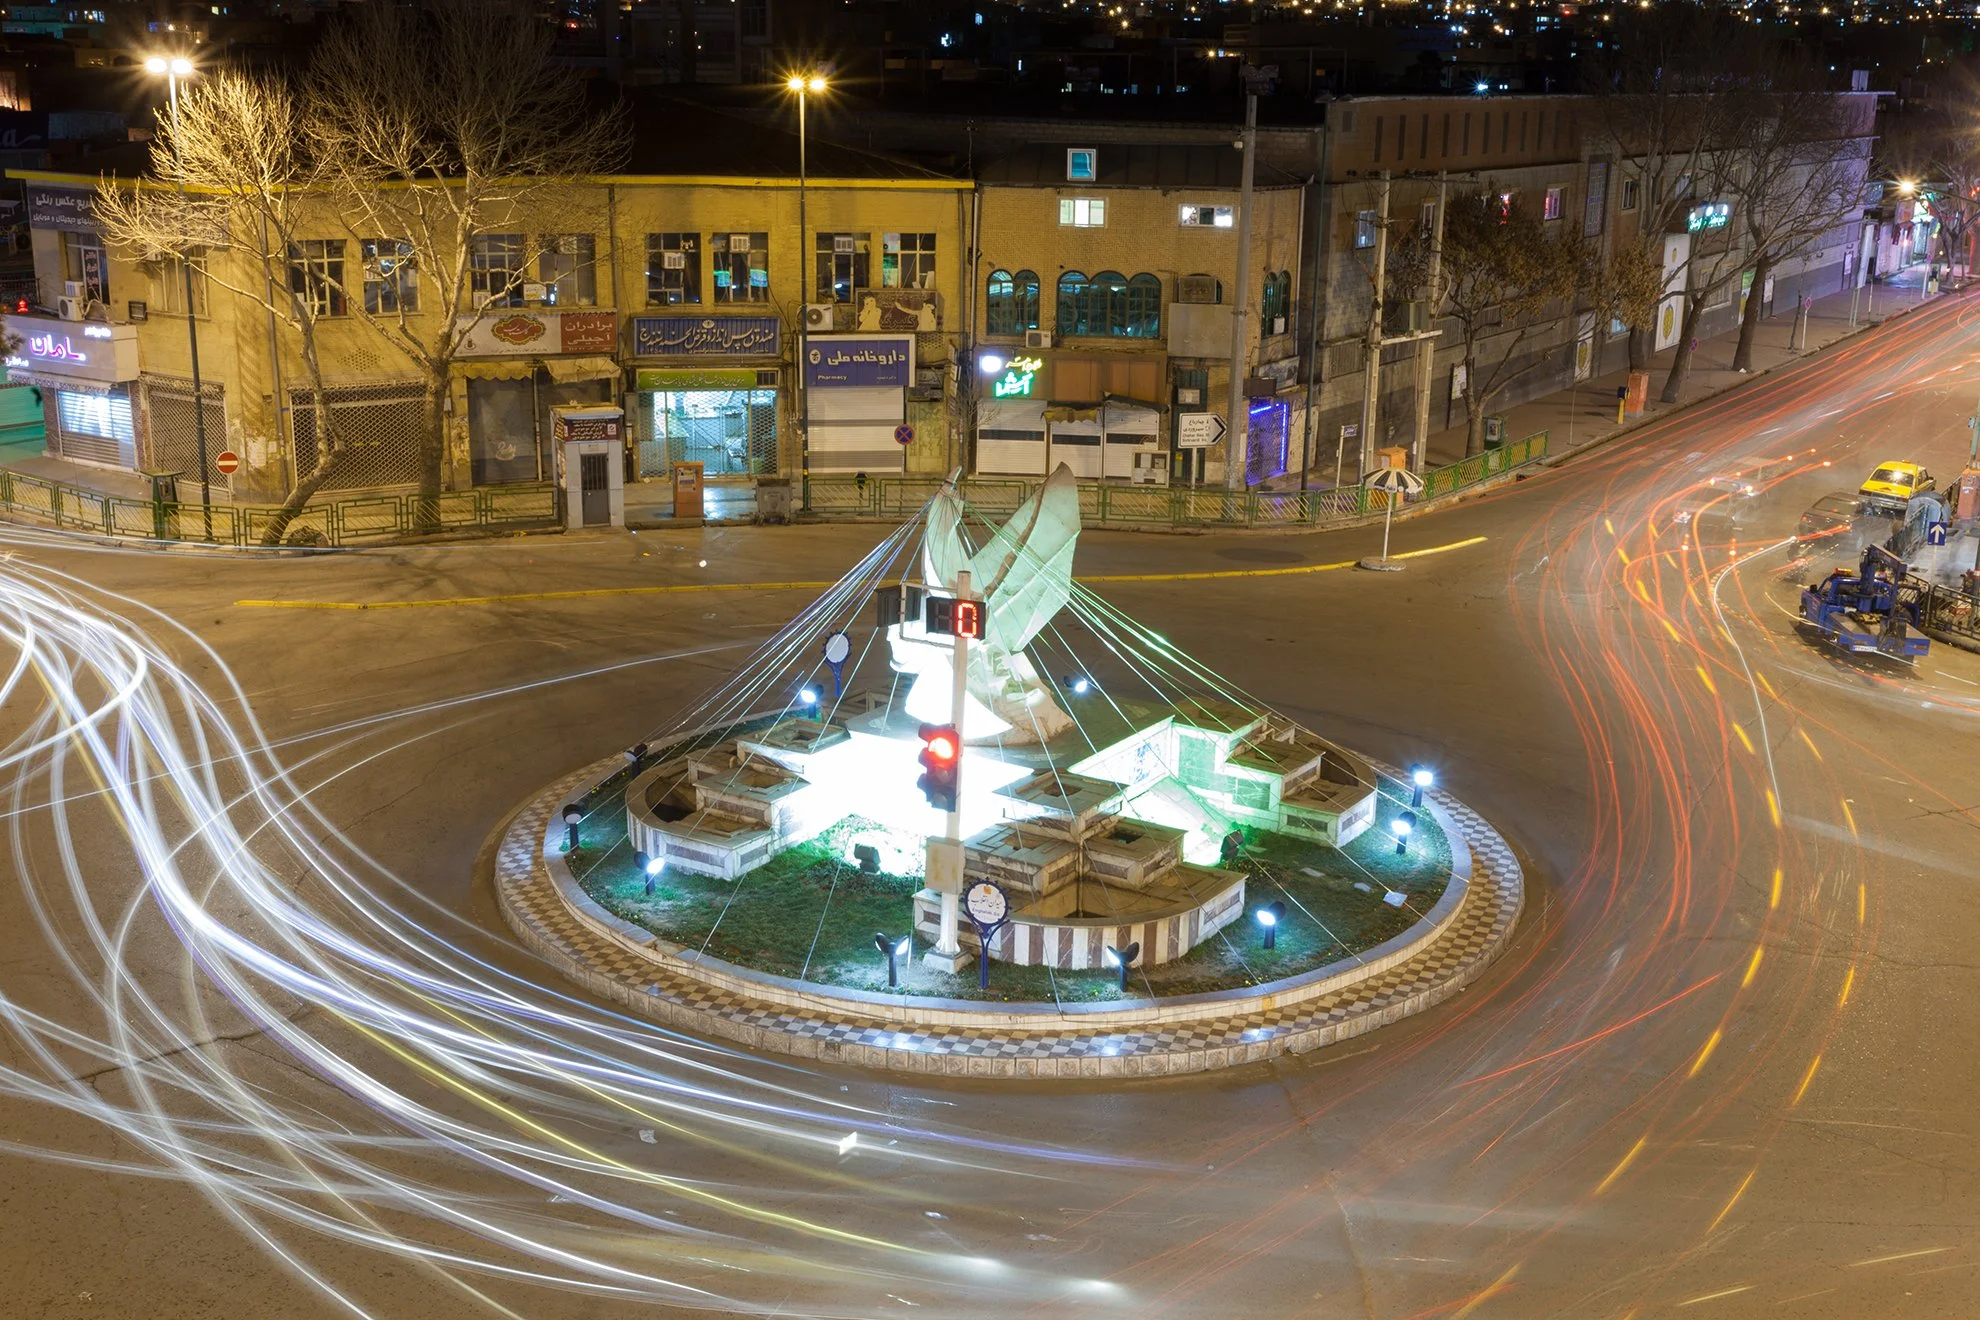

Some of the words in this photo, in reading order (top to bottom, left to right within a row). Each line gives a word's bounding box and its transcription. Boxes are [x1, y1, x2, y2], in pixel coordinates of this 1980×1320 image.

[35, 193, 53, 207] رنگی
[55, 196, 76, 207] عکس
[564, 320, 613, 332] برادران
[567, 332, 612, 345] آجیلی
[639, 327, 664, 346] سنندج
[722, 327, 754, 350] پس
[743, 328, 775, 348] صندوق
[30, 334, 87, 362] سامان
[827, 349, 851, 366] ملی
[852, 349, 906, 365] داروخانه
